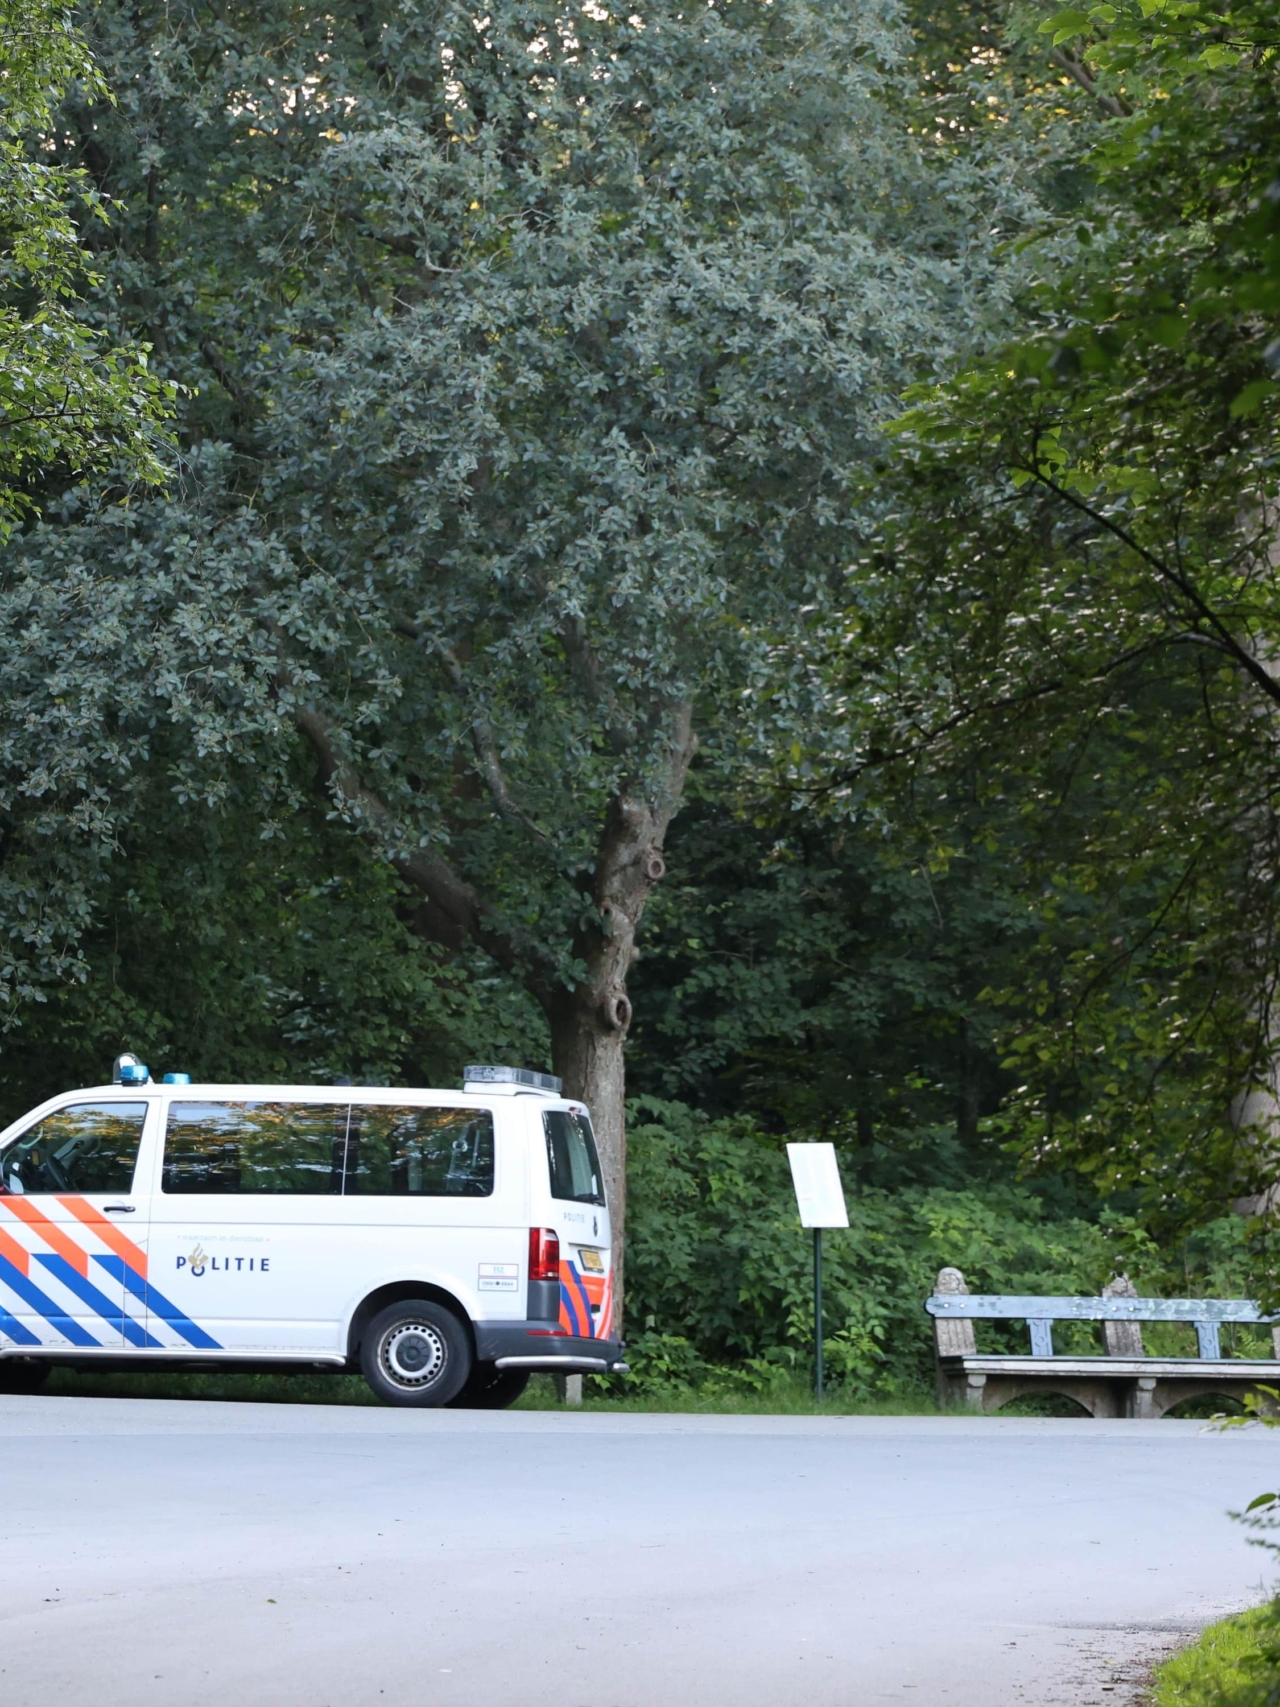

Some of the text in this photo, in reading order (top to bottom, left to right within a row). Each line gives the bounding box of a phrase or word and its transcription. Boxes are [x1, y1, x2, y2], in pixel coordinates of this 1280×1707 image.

[563, 1212, 585, 1223] POLITIE
[176, 1255, 270, 1277] POLITIE
[493, 1266, 504, 1274] 112
